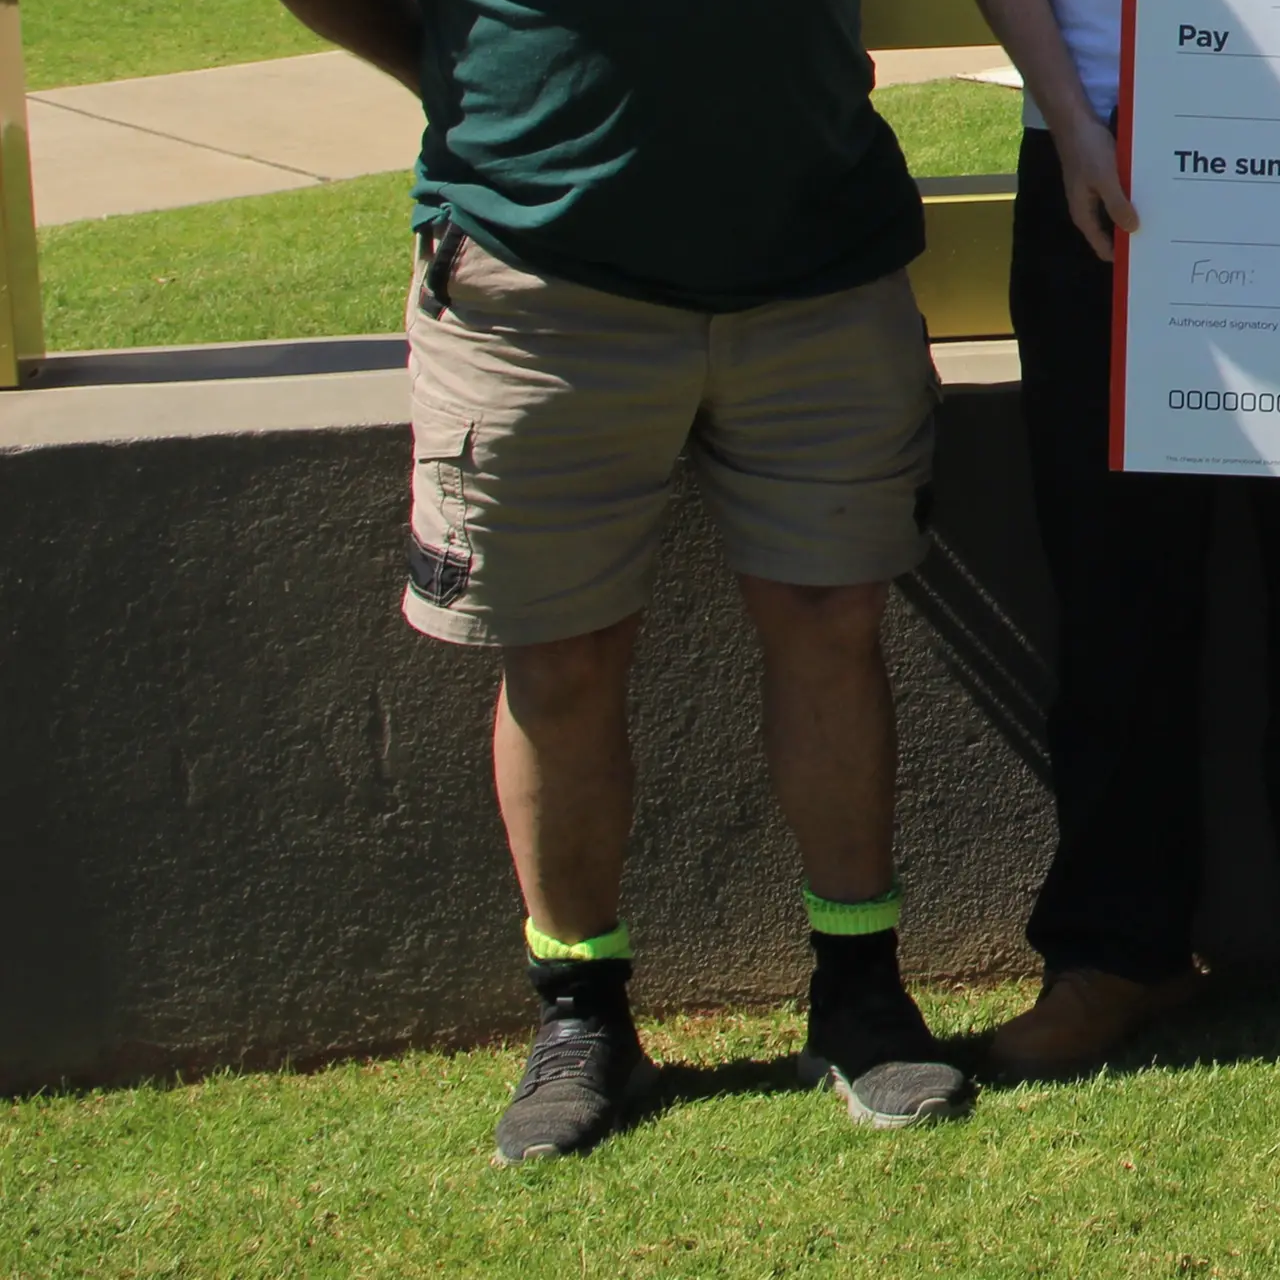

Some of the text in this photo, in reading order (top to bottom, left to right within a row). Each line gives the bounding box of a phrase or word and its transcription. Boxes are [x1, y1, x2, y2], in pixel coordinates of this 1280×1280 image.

[1178, 24, 1230, 52] Pay
[1174, 150, 1227, 174] The
[1190, 259, 1256, 286] From:
[1168, 317, 1279, 332] Authorised signatory
